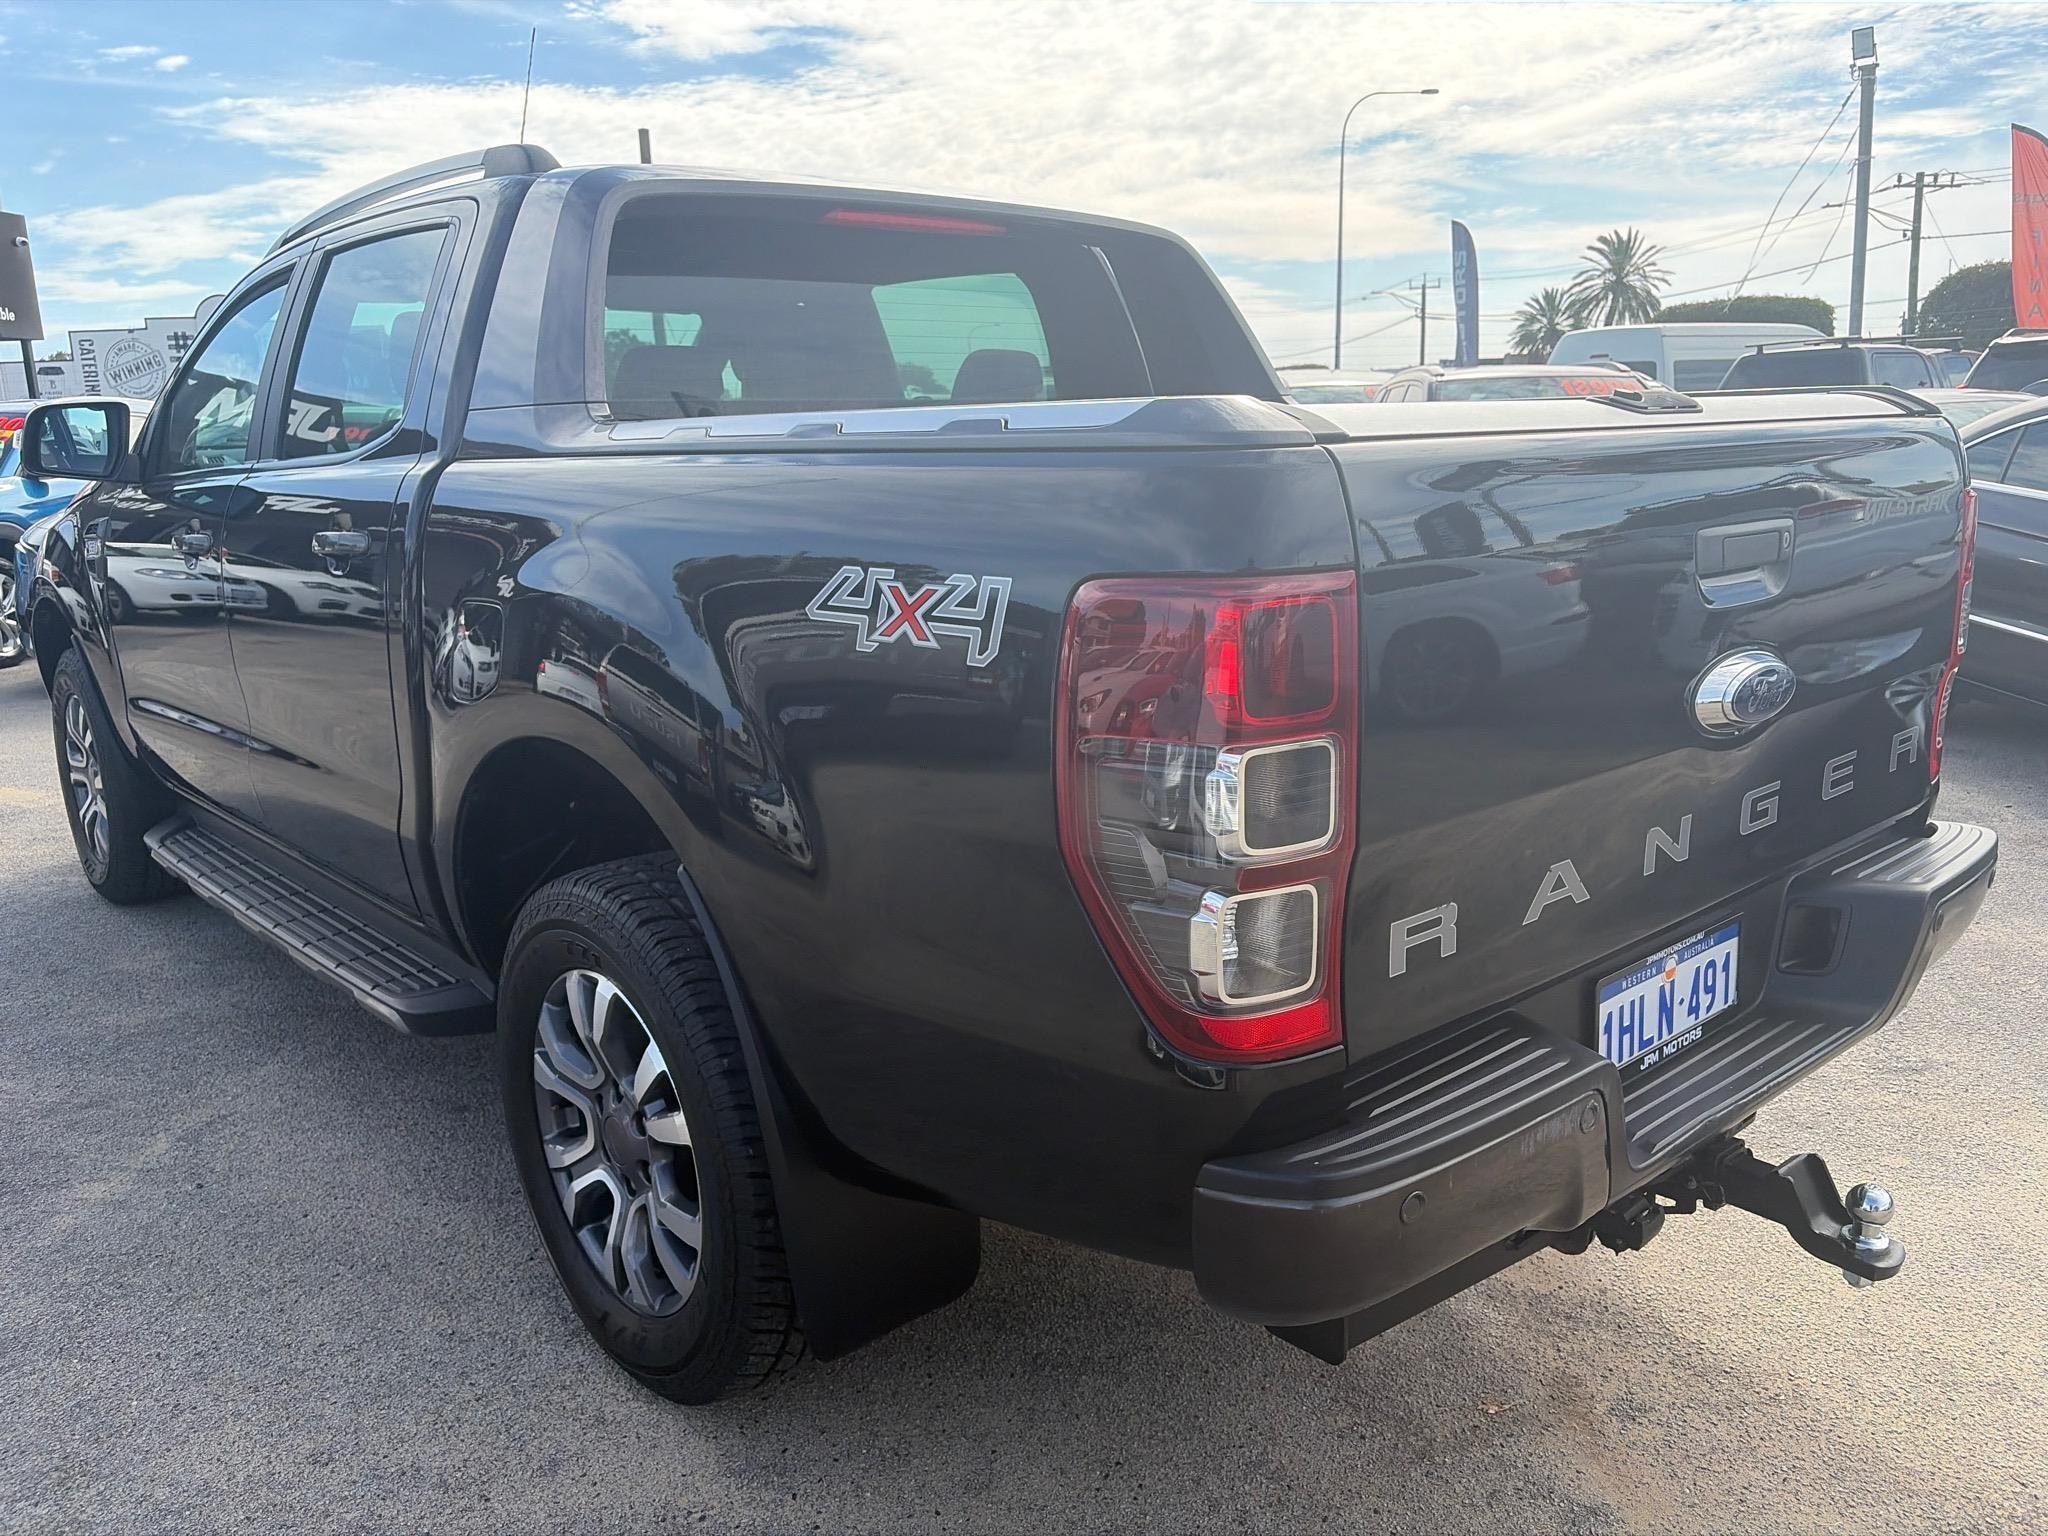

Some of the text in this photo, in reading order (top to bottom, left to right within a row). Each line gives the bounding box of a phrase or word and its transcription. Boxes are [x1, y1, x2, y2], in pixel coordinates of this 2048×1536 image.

[108, 353, 163, 385] WINNING
[1864, 494, 1952, 526] WILDTRAK
[1748, 673, 1791, 713] Ford
[1388, 726, 1920, 979] RANGER
[1622, 935, 1715, 991] WESTERN AUSTRALIA
[1640, 1025, 1703, 1071] JPM MOTORS
